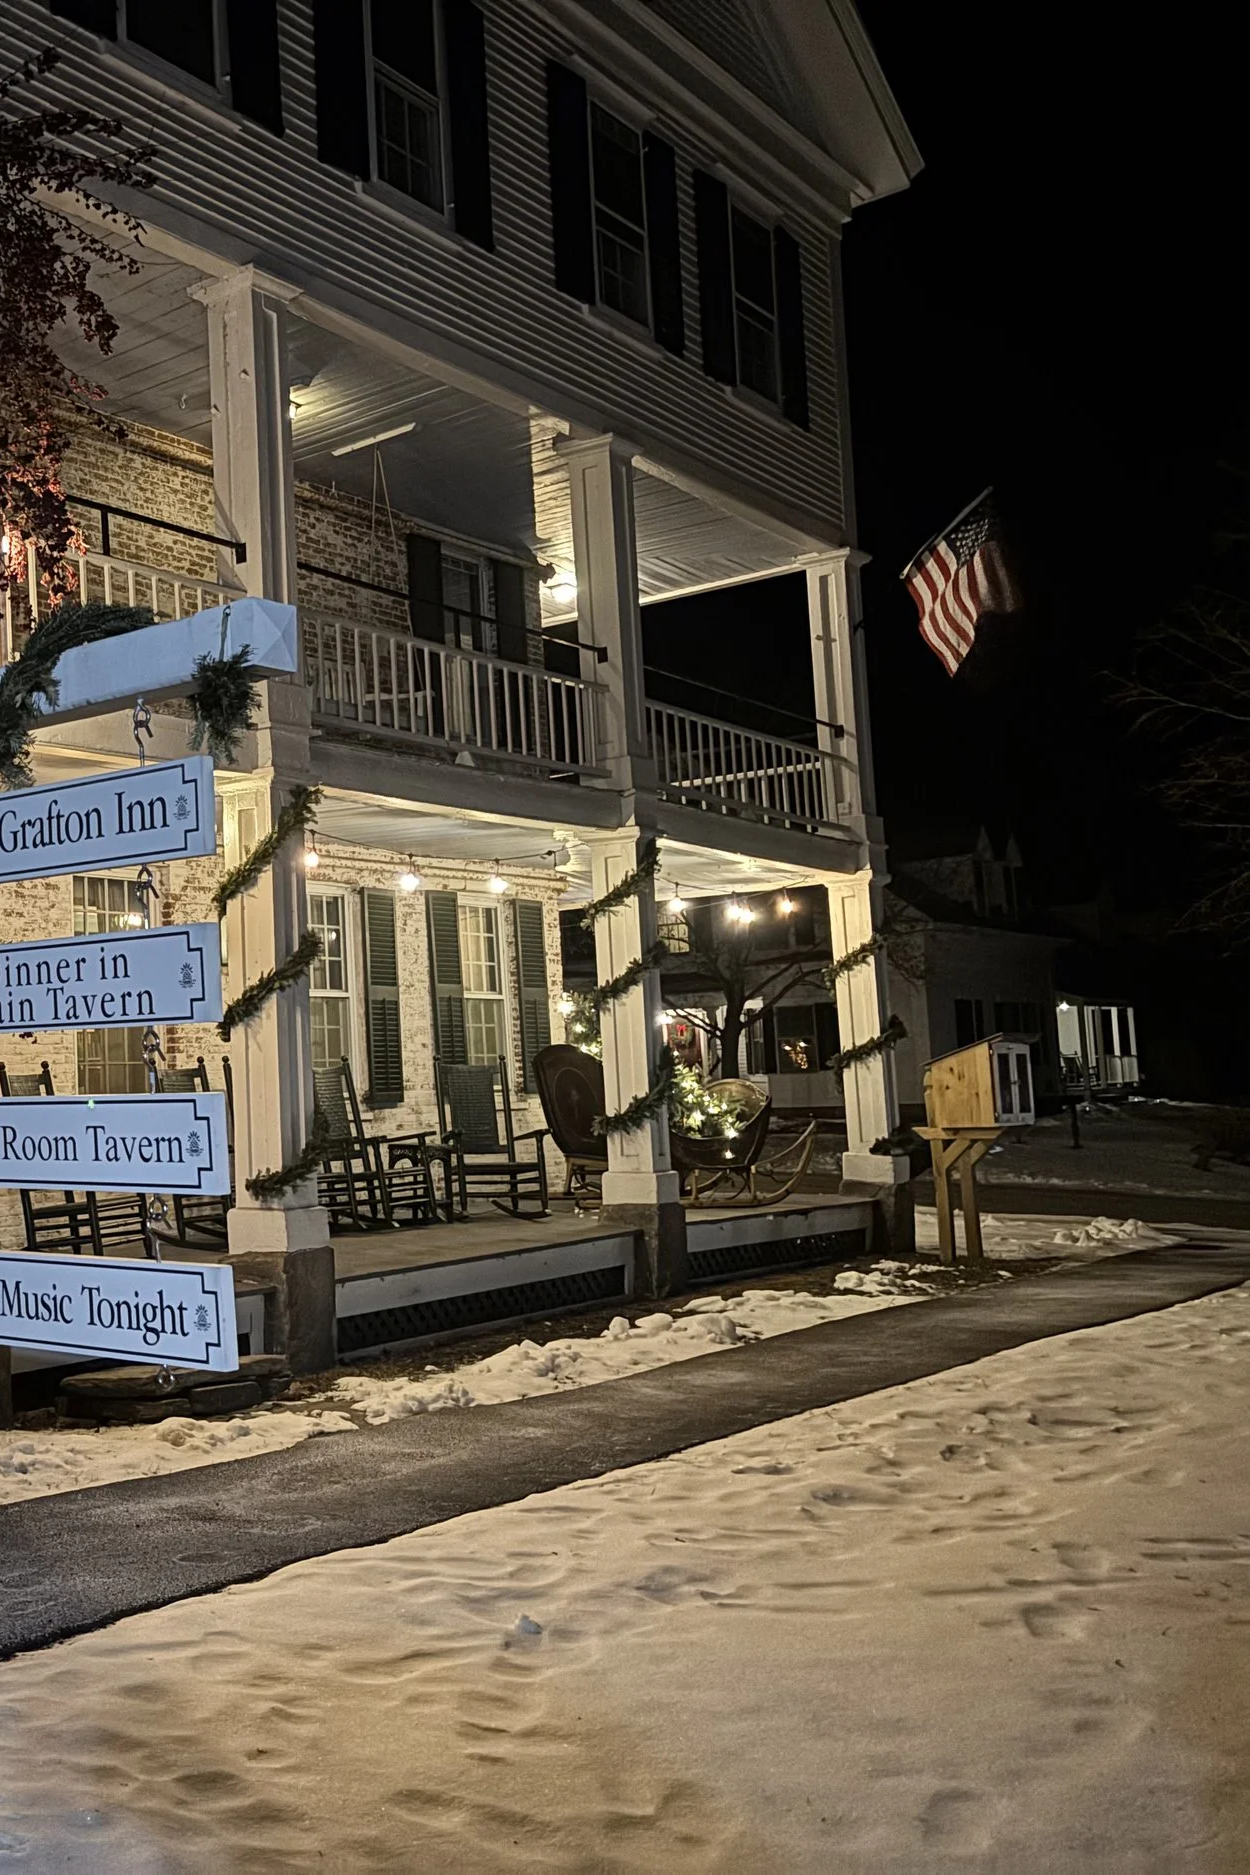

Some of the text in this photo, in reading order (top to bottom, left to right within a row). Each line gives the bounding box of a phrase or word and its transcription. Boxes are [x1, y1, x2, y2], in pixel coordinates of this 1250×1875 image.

[114, 791, 170, 836] Inn
[99, 946, 130, 980] in
[46, 986, 156, 1021] Tavern
[0, 1125, 79, 1162] Room
[85, 1125, 186, 1164] Tavern
[0, 1278, 74, 1324] Music
[81, 1284, 190, 1346] Tonight
